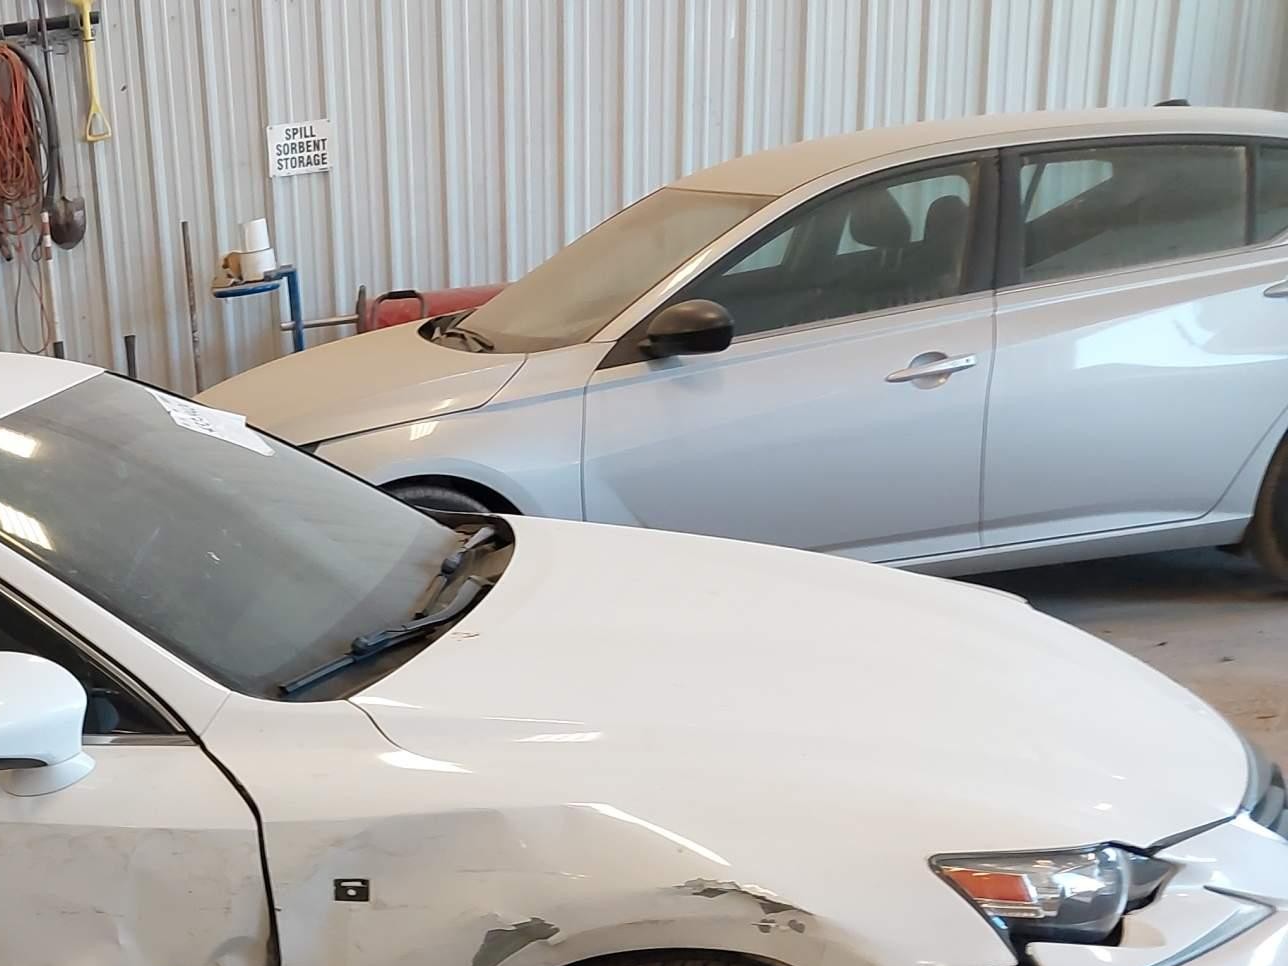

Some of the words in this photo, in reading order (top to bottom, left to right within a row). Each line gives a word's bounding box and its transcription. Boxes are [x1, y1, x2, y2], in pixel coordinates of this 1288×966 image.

[284, 125, 316, 141] SPILL
[275, 138, 328, 157] SORBENT
[276, 153, 328, 171] STORAGE
